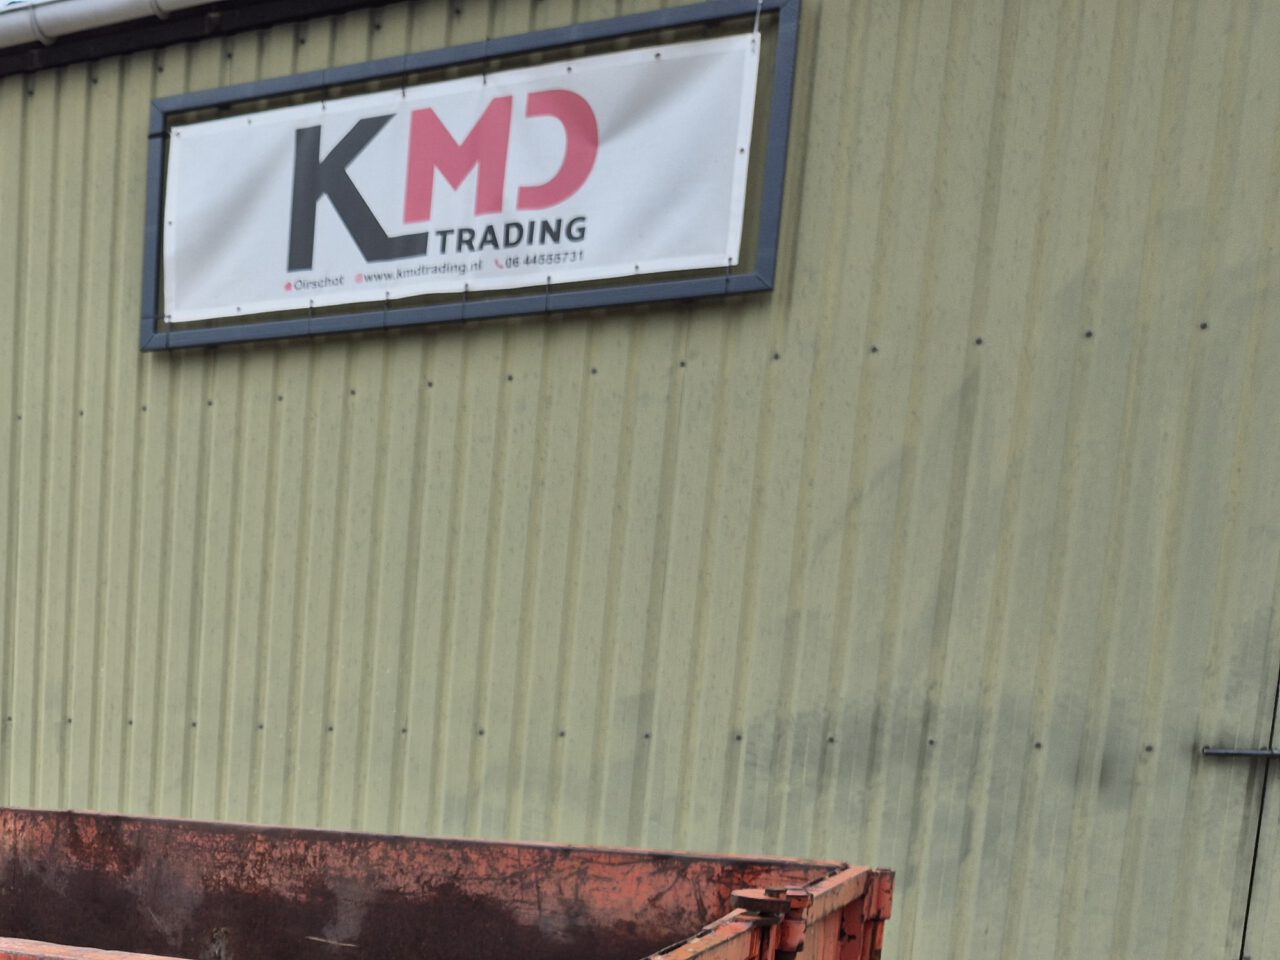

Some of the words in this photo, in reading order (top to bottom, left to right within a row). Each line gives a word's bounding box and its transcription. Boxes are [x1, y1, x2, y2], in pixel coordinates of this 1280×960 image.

[287, 89, 599, 271] KMD
[435, 216, 587, 255] TRADING
[293, 275, 345, 292] Oirschot
[363, 259, 483, 283] www.kmdtrading.nl
